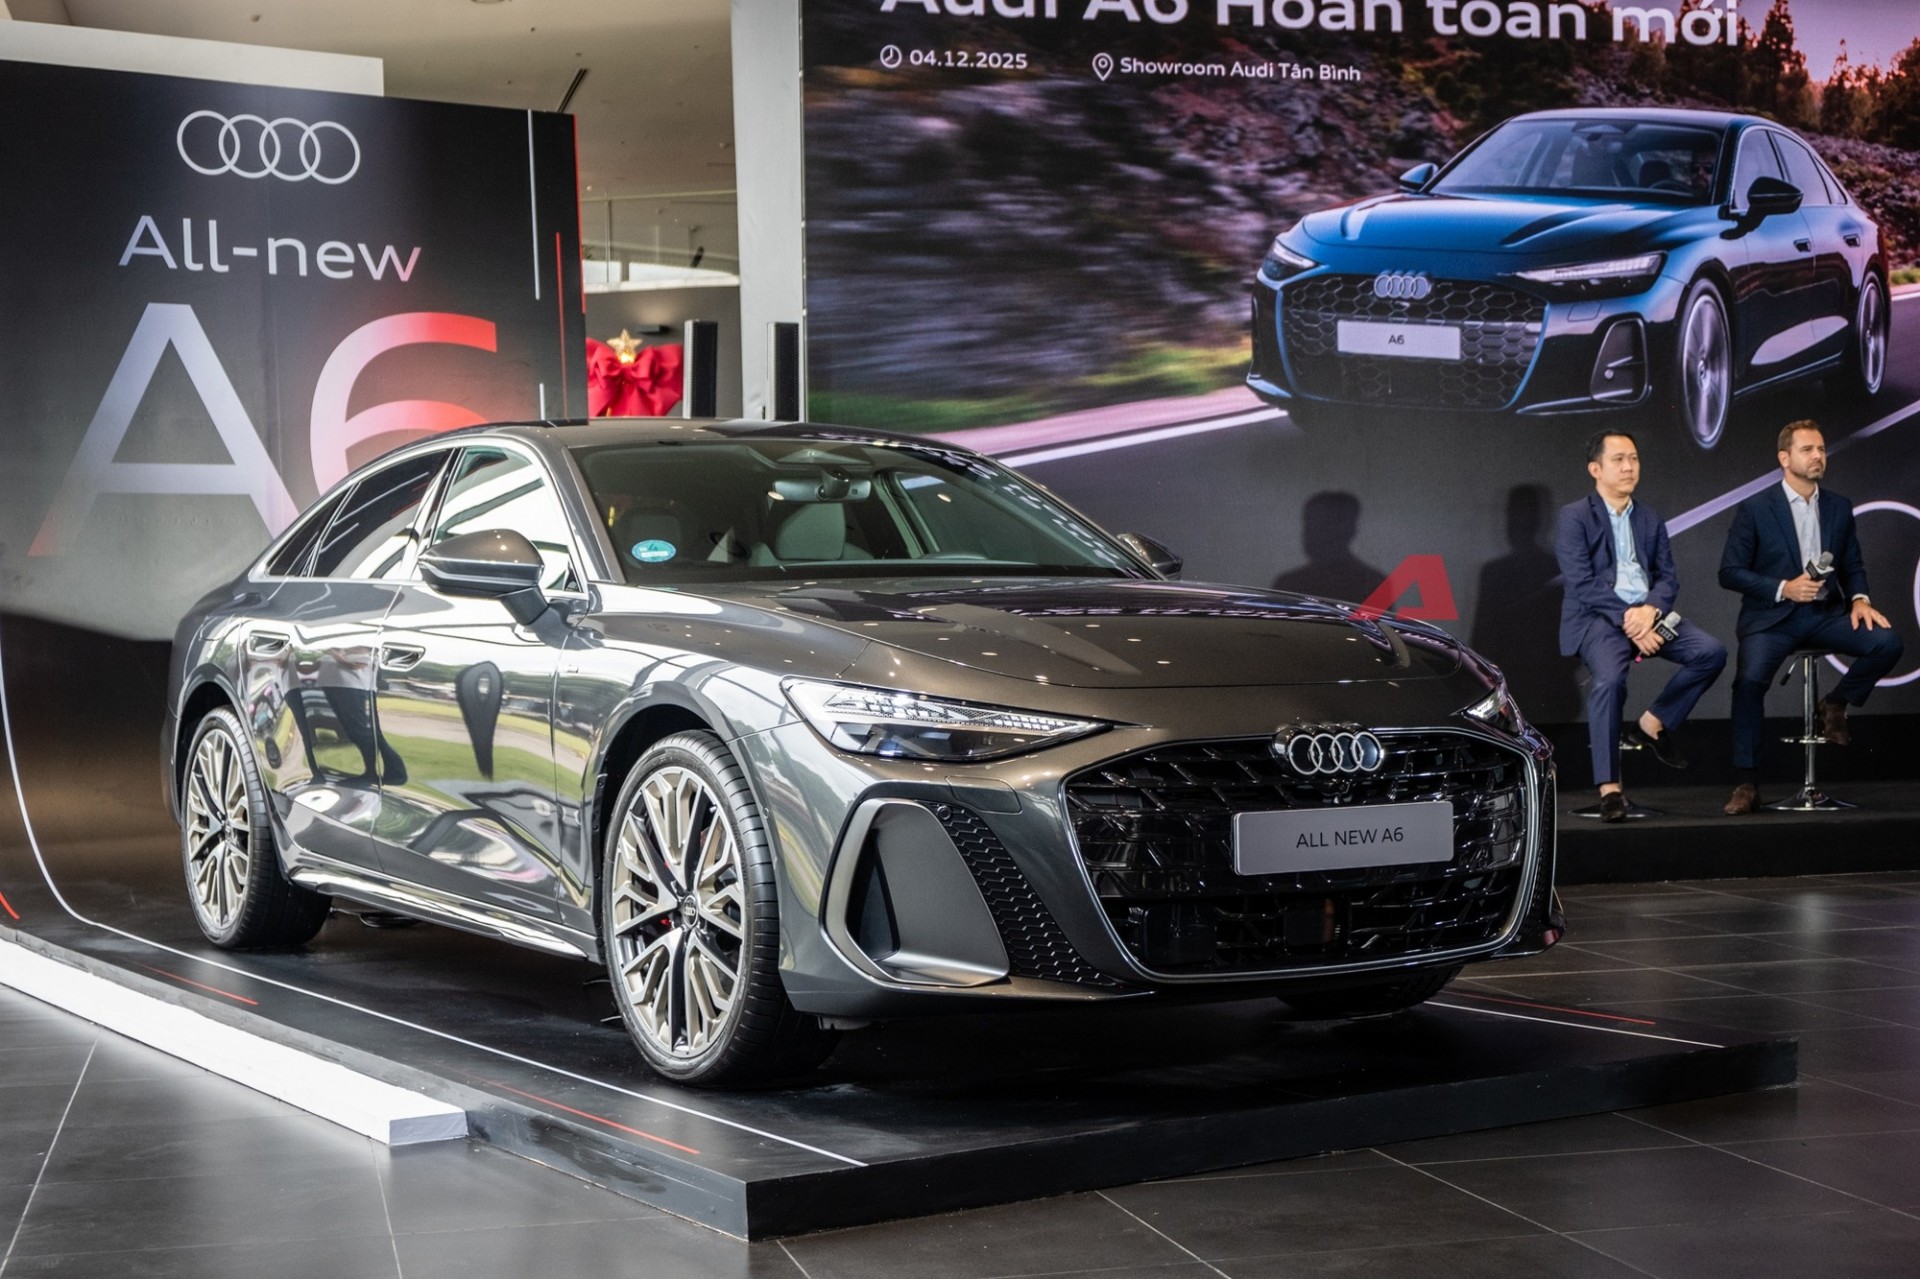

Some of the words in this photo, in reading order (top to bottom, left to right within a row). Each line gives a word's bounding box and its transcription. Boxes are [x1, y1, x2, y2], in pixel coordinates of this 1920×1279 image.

[909, 49, 1028, 69] 04.12.2025
[1120, 57, 1226, 77] Showroom
[1230, 61, 1274, 78] Audi
[1278, 62, 1314, 79] Tân
[1319, 63, 1361, 81] Bình
[118, 214, 422, 282] All-new
[1389, 335, 1405, 345] A6
[1296, 832, 1329, 849] ALL
[1334, 828, 1378, 846] NEW
[1381, 826, 1404, 843] A6
